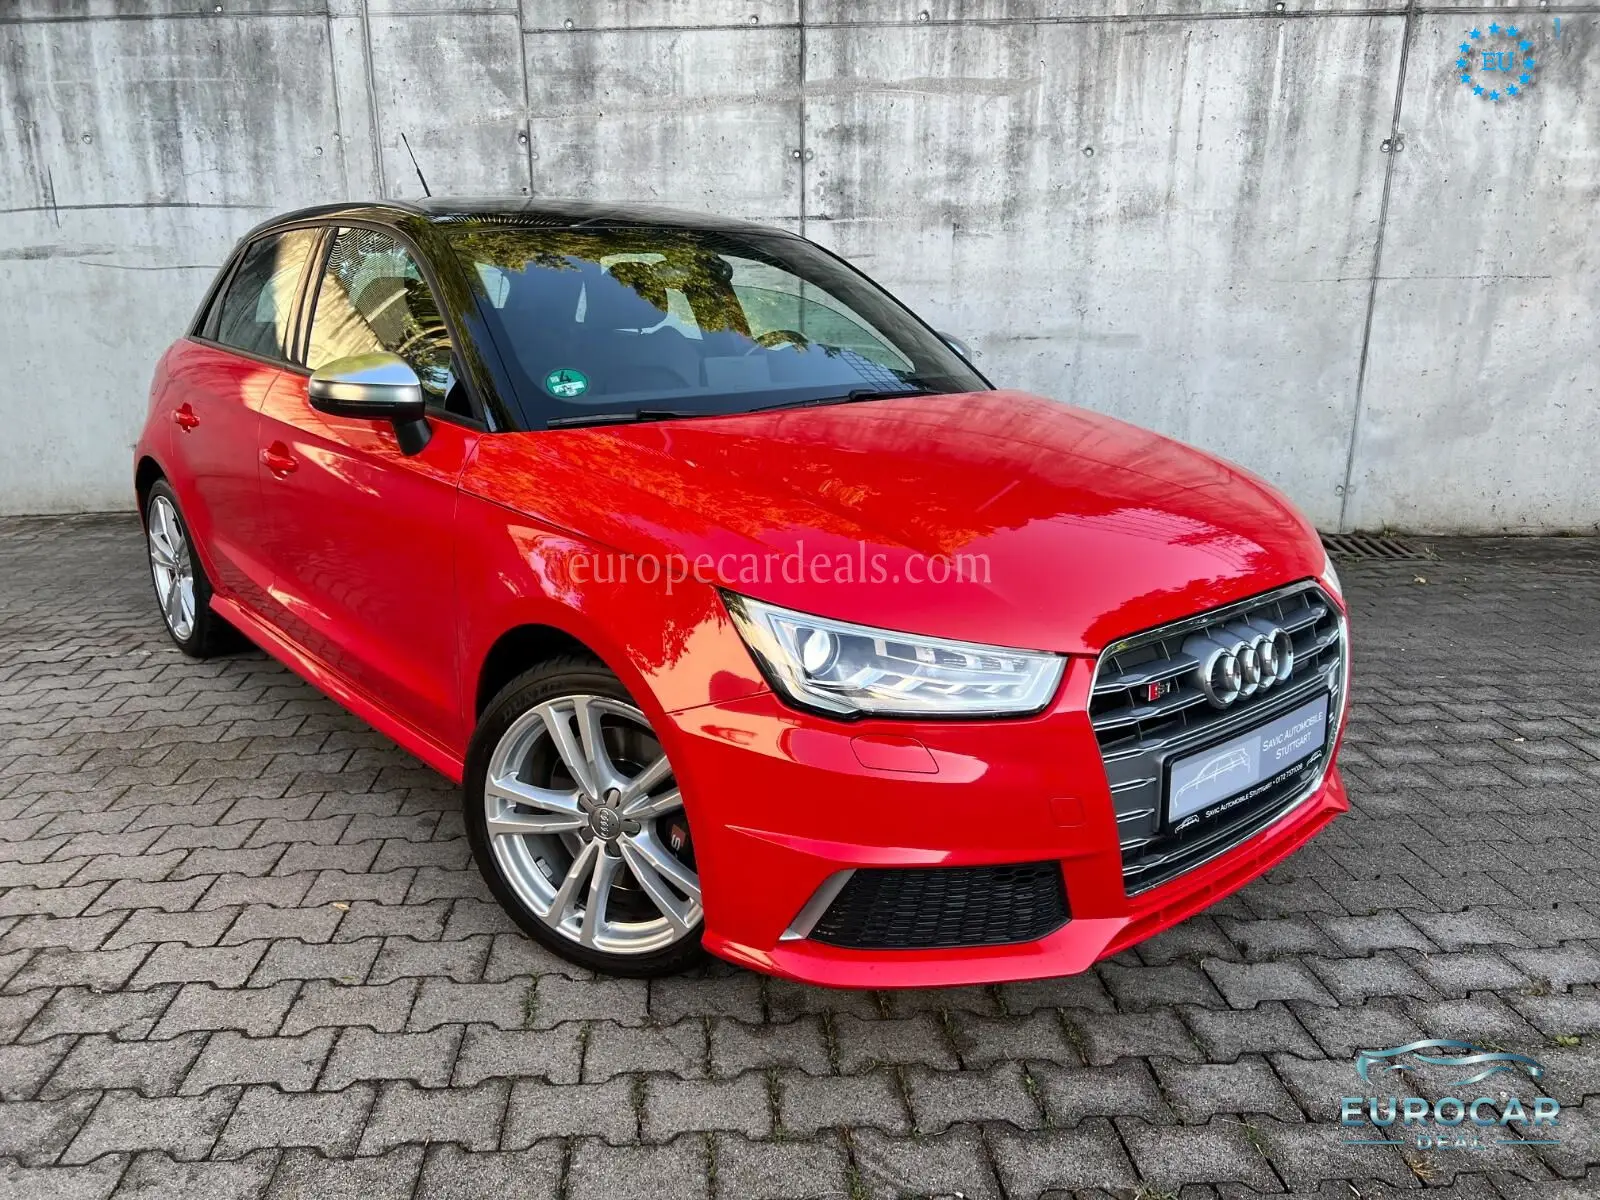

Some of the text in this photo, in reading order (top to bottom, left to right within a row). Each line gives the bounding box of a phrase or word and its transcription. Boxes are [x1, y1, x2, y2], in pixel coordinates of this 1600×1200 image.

[1262, 711, 1323, 752] SAVIC AUTOMOBILE
[1275, 731, 1312, 760] STUTTGART
